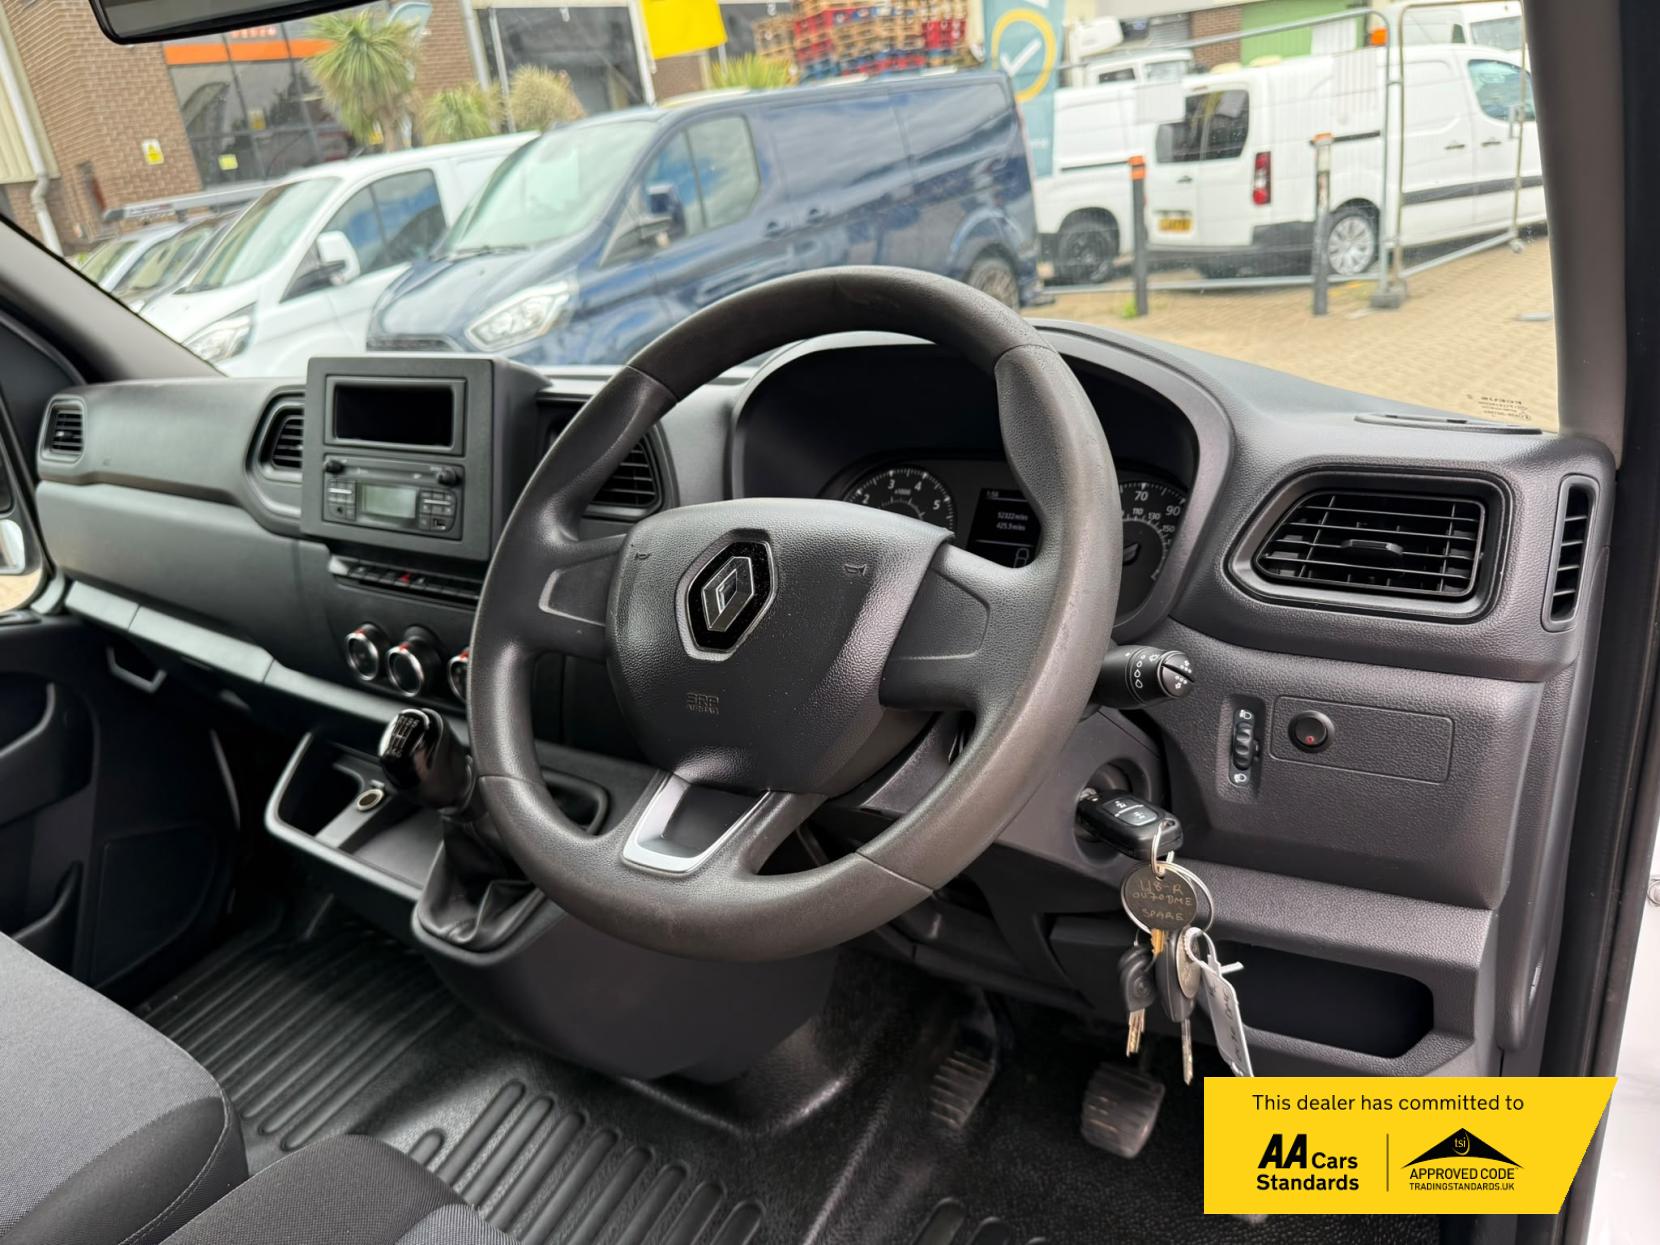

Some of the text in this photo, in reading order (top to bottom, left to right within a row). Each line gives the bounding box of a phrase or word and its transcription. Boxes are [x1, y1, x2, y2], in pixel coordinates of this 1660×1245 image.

[888, 479, 895, 489] 3
[914, 481, 922, 491] 4
[862, 493, 870, 504] 2
[1134, 491, 1148, 501] 70
[933, 500, 940, 510] 5
[1165, 505, 1180, 516] 90
[1142, 908, 1184, 921] SPARE
